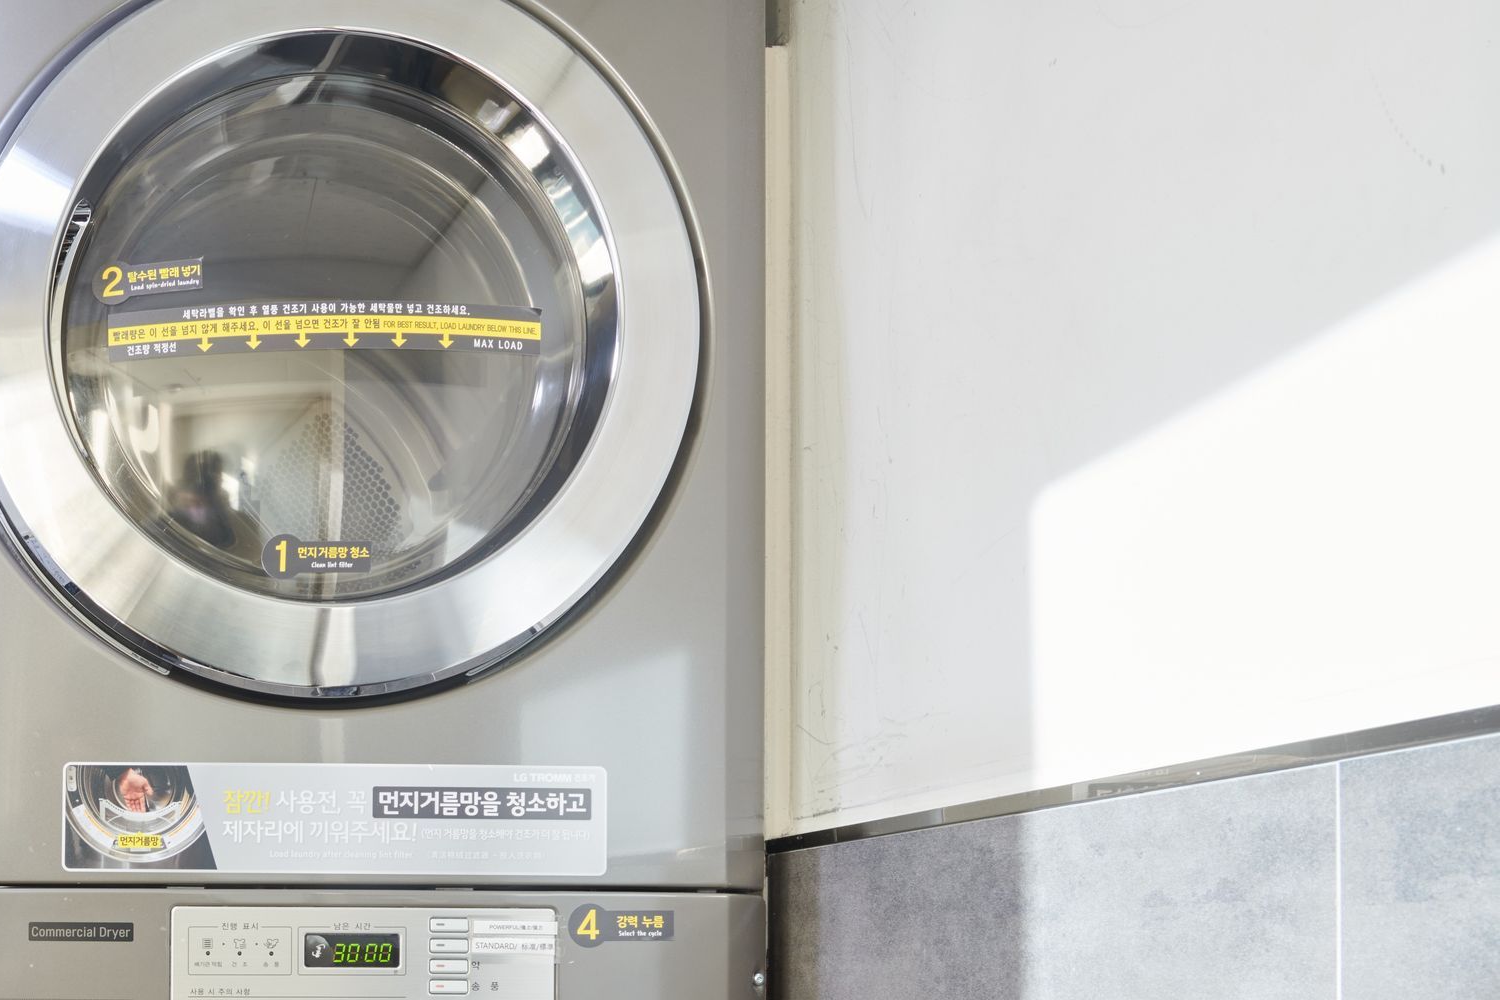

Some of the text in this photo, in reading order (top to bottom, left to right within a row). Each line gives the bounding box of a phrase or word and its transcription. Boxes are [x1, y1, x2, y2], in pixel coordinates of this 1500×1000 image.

[102, 266, 124, 297] 2
[127, 265, 200, 283] 탈수된 빨래 넣기
[183, 303, 470, 319] 세탁라벨을 확인 후 열풍 건조기 사용이 가능한 세탁물만 넣고 건조하세요.
[127, 342, 177, 355] 건조량 적정선
[474, 339, 523, 350] MAX LOAD
[276, 541, 286, 572] 1
[350, 547, 369, 558] 청소
[514, 773, 571, 783] LG TROMM
[223, 789, 270, 814] 잠깐!
[347, 791, 367, 815] 꼭
[379, 791, 501, 817] 먼지거름망을
[507, 791, 587, 817] 청소하고
[222, 820, 417, 845] 제자리에 끼워주세요!
[119, 836, 159, 847] 먼지거름망
[577, 909, 599, 939] 4
[617, 916, 664, 928] 강력 누름
[31, 926, 130, 940] Commercial Dryer
